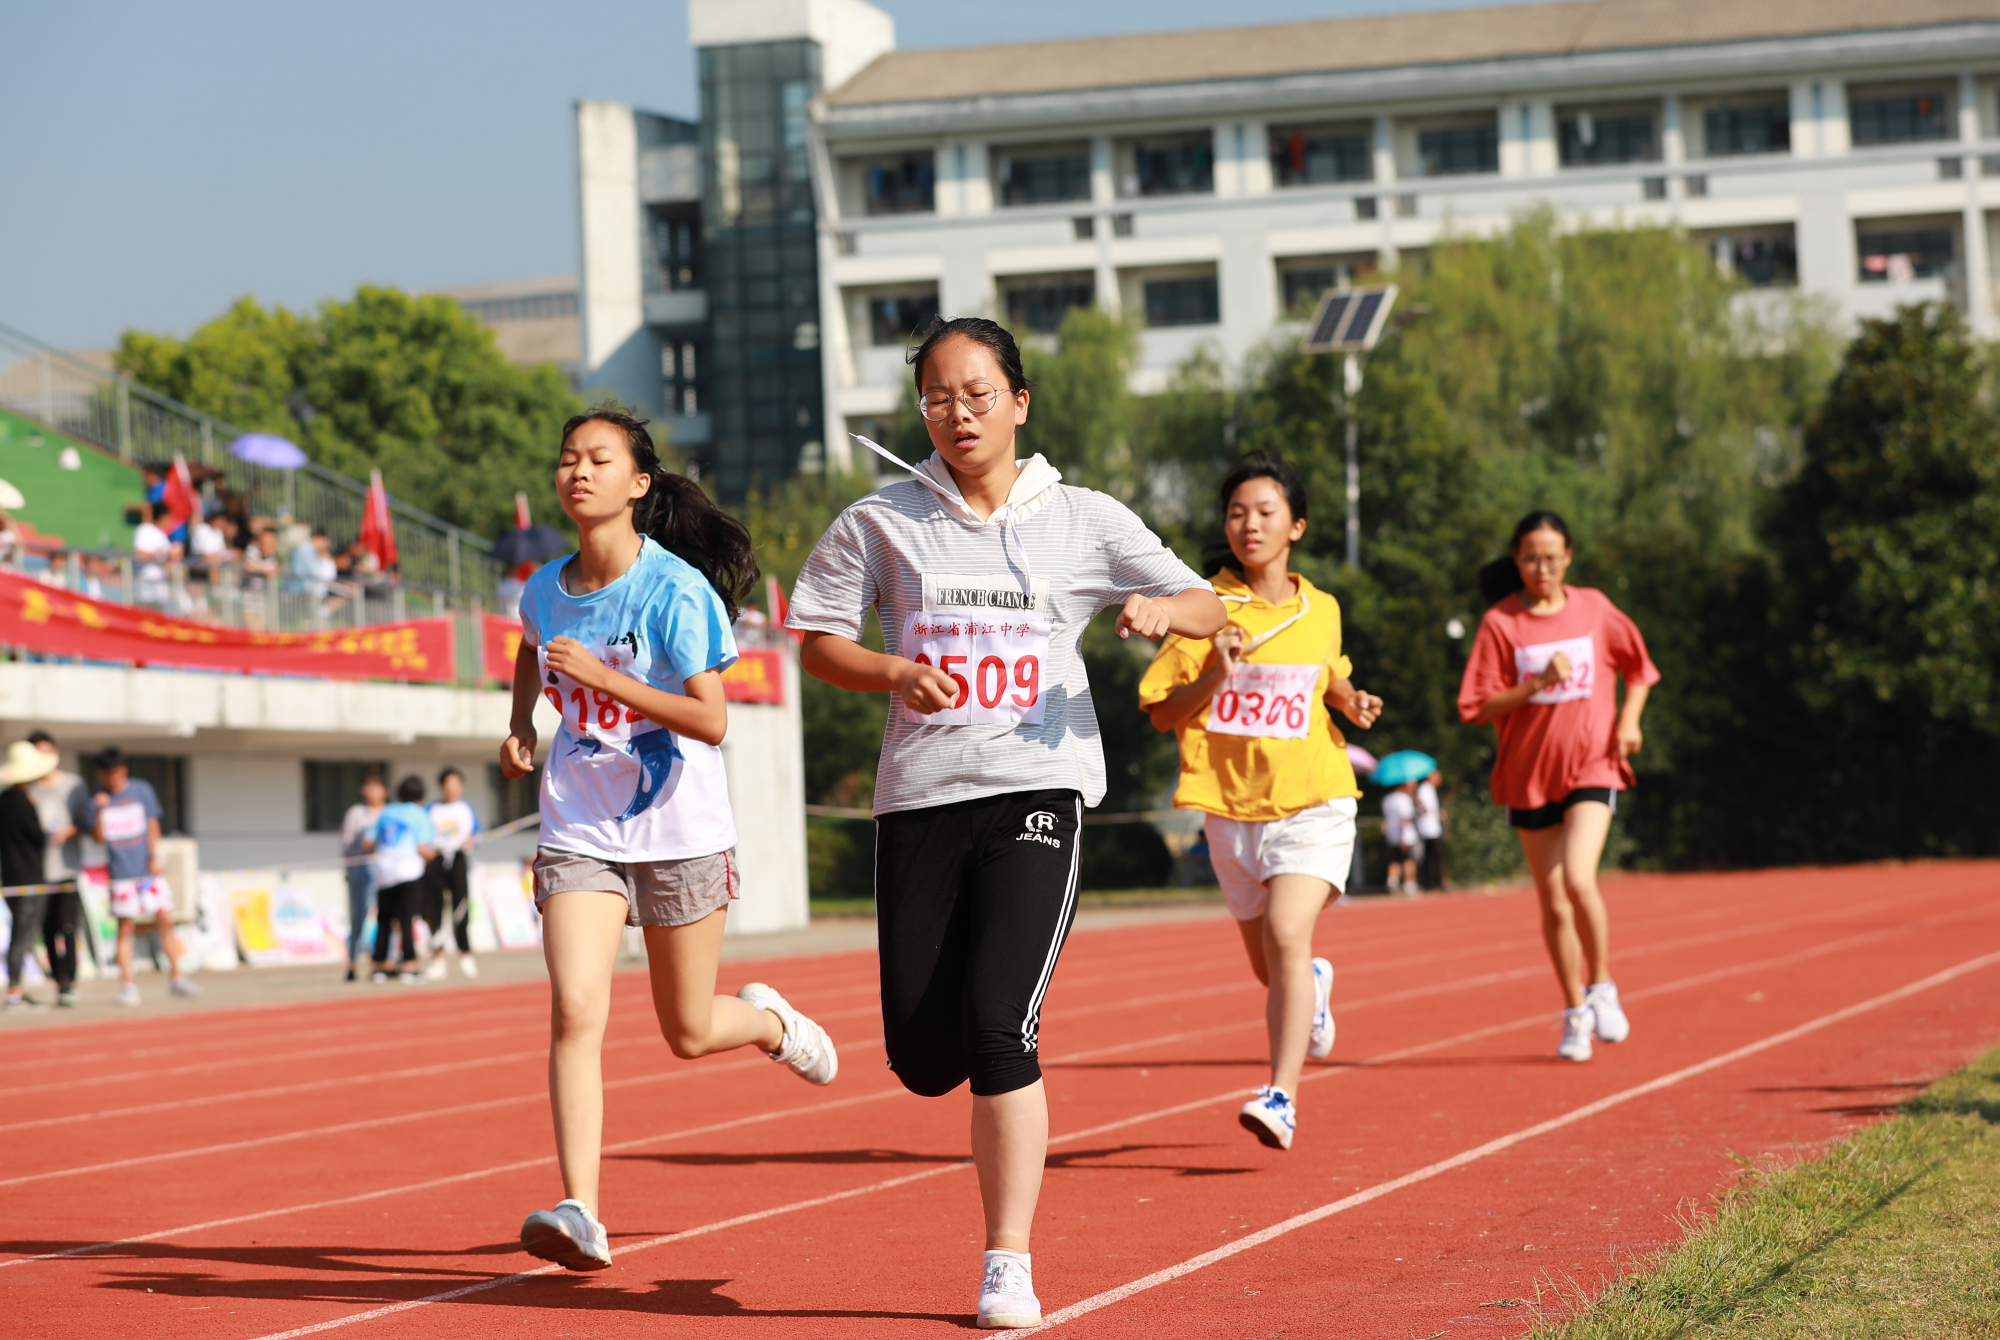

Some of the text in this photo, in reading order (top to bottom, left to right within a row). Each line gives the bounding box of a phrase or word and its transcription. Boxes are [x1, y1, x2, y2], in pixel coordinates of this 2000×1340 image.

[936, 588, 1036, 610] FRENCH CHANCE
[914, 621, 1030, 638] 浙江省浦江中学
[1217, 689, 1305, 729] 0306
[1015, 832, 1061, 849] JEANS
